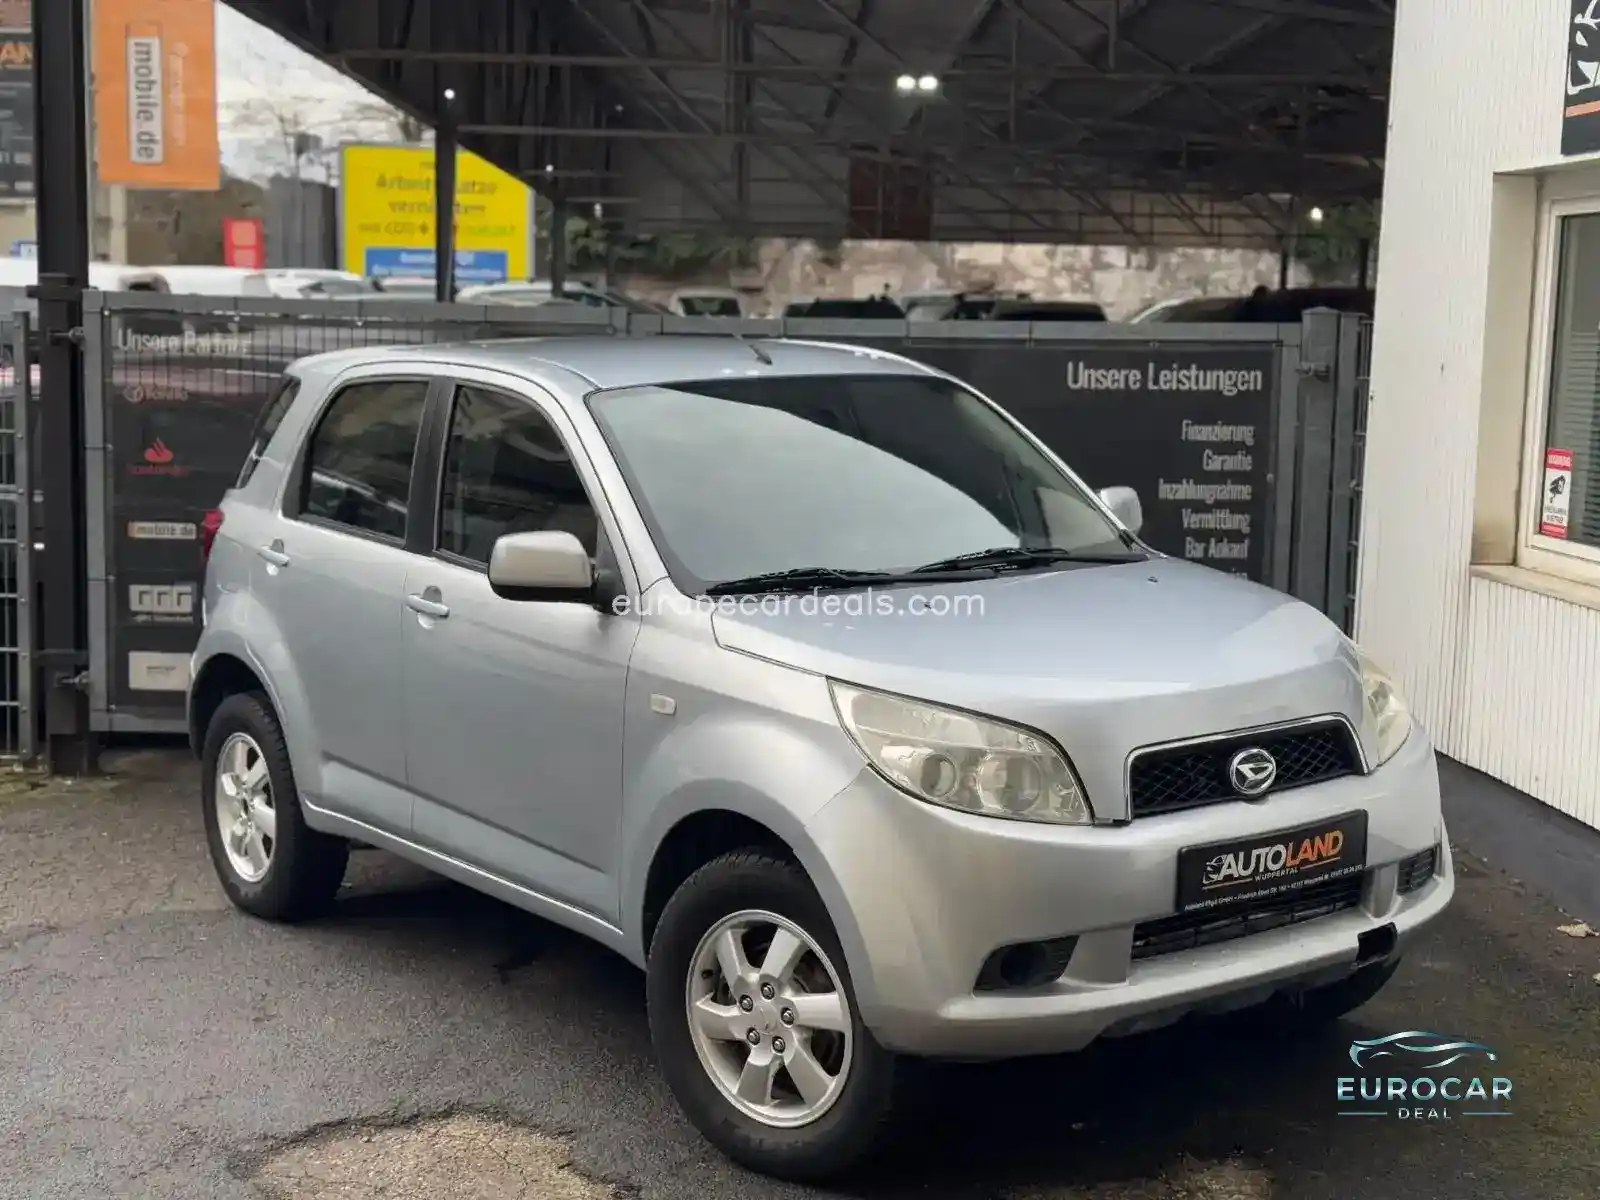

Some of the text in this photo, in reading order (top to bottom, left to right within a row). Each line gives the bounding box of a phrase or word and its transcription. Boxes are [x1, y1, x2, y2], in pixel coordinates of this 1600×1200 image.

[1067, 361, 1262, 396] Unsere Leistungen
[1181, 419, 1254, 446] Finanzierung
[1203, 448, 1252, 471] Garantie
[1182, 507, 1251, 534] Vermittlung
[1185, 537, 1249, 558] Bar Ankauf
[1218, 829, 1343, 881] AUTOLAND
[1254, 867, 1299, 883] WUPPERTAL
